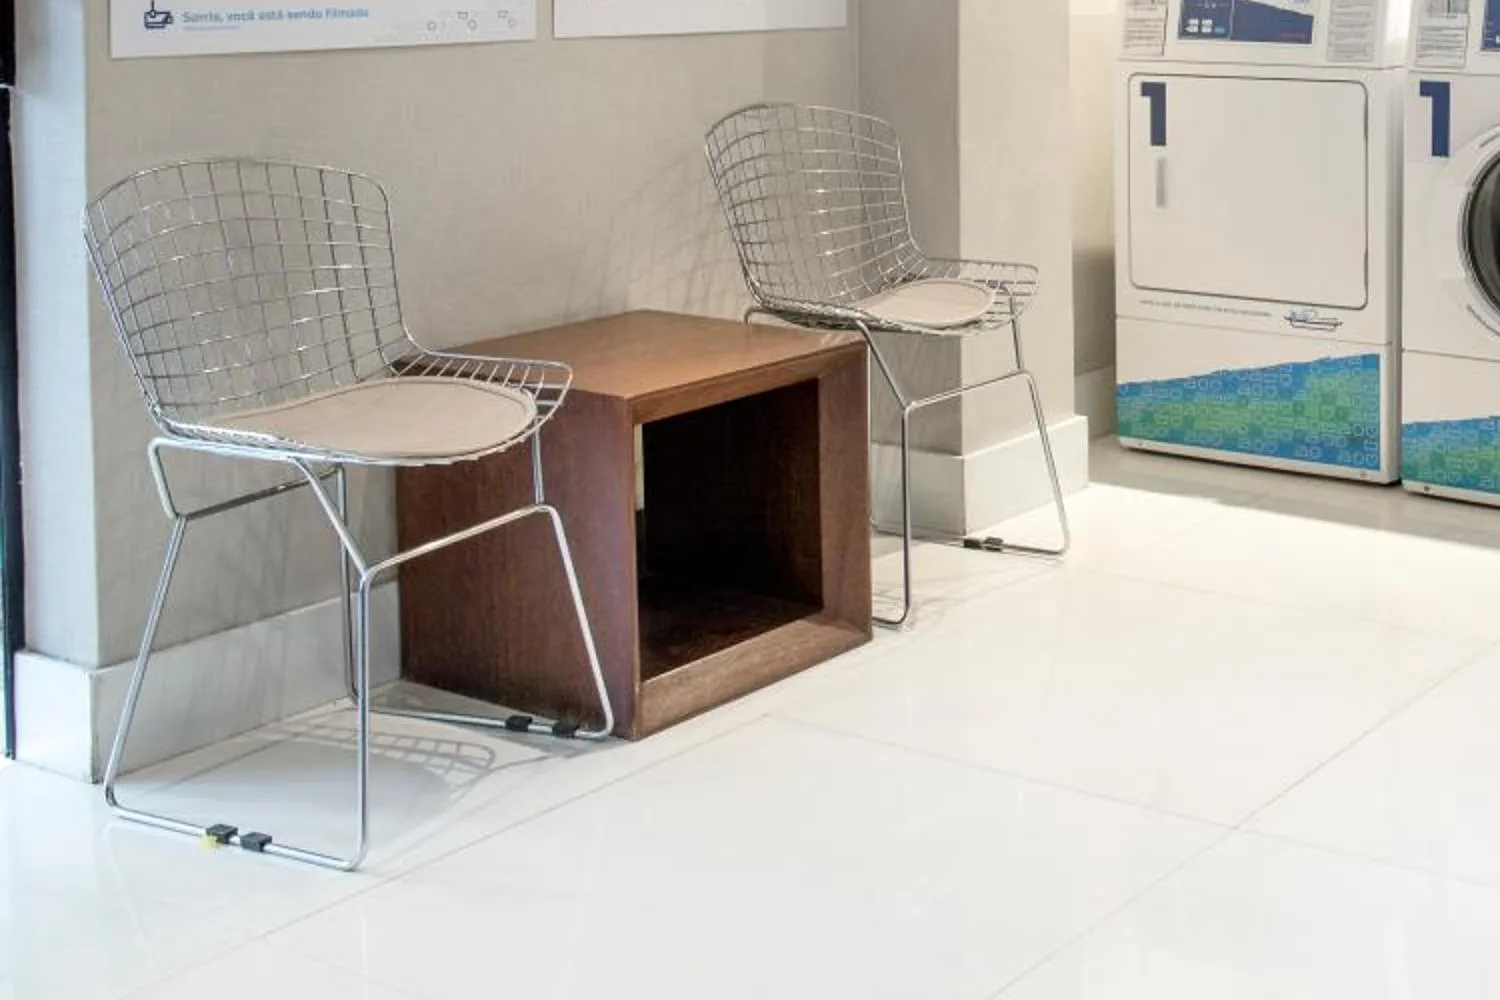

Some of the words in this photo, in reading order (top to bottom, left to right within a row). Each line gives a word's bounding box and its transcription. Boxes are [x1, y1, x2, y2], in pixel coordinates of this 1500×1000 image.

[227, 8, 255, 22] você
[1141, 81, 1166, 146] 1
[1419, 80, 1451, 157] 1
